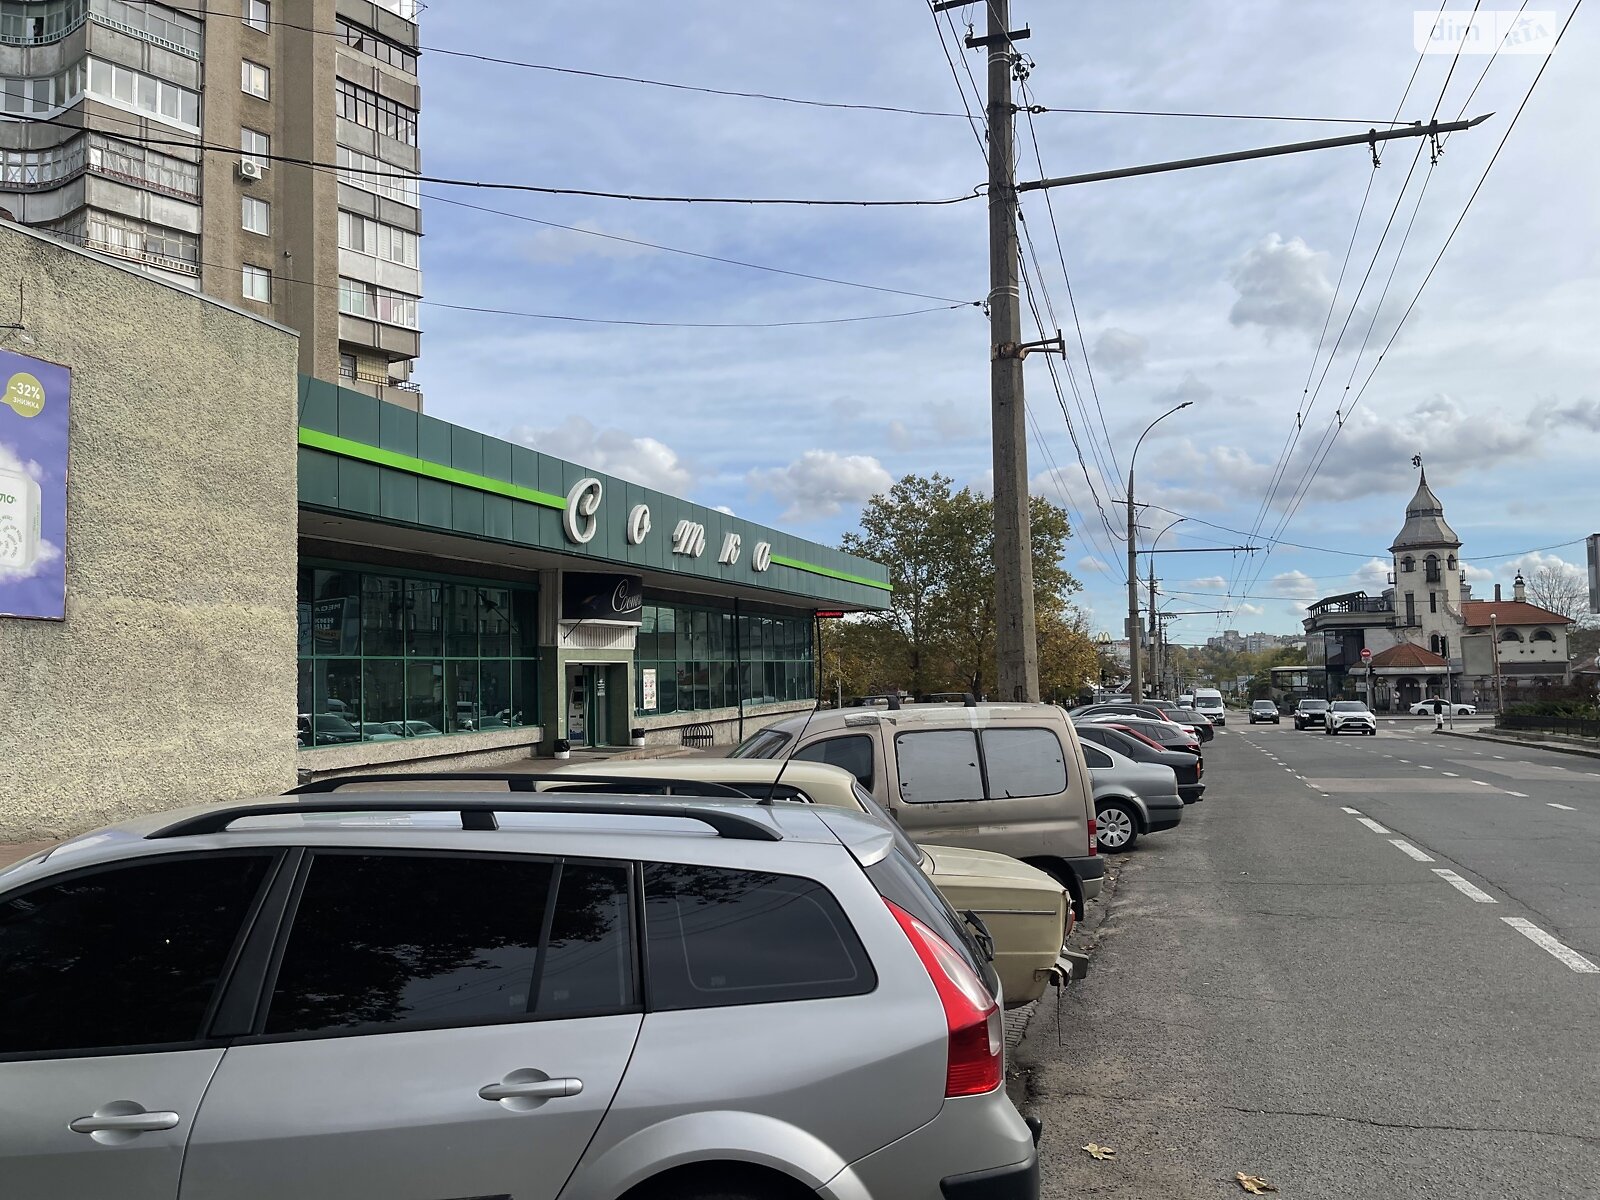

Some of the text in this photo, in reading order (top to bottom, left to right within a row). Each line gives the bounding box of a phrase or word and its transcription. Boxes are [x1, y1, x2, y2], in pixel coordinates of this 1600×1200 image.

[10, 382, 41, 400] -32%
[13, 396, 40, 410] ЗНИЖКА
[562, 477, 771, 572] Сотка
